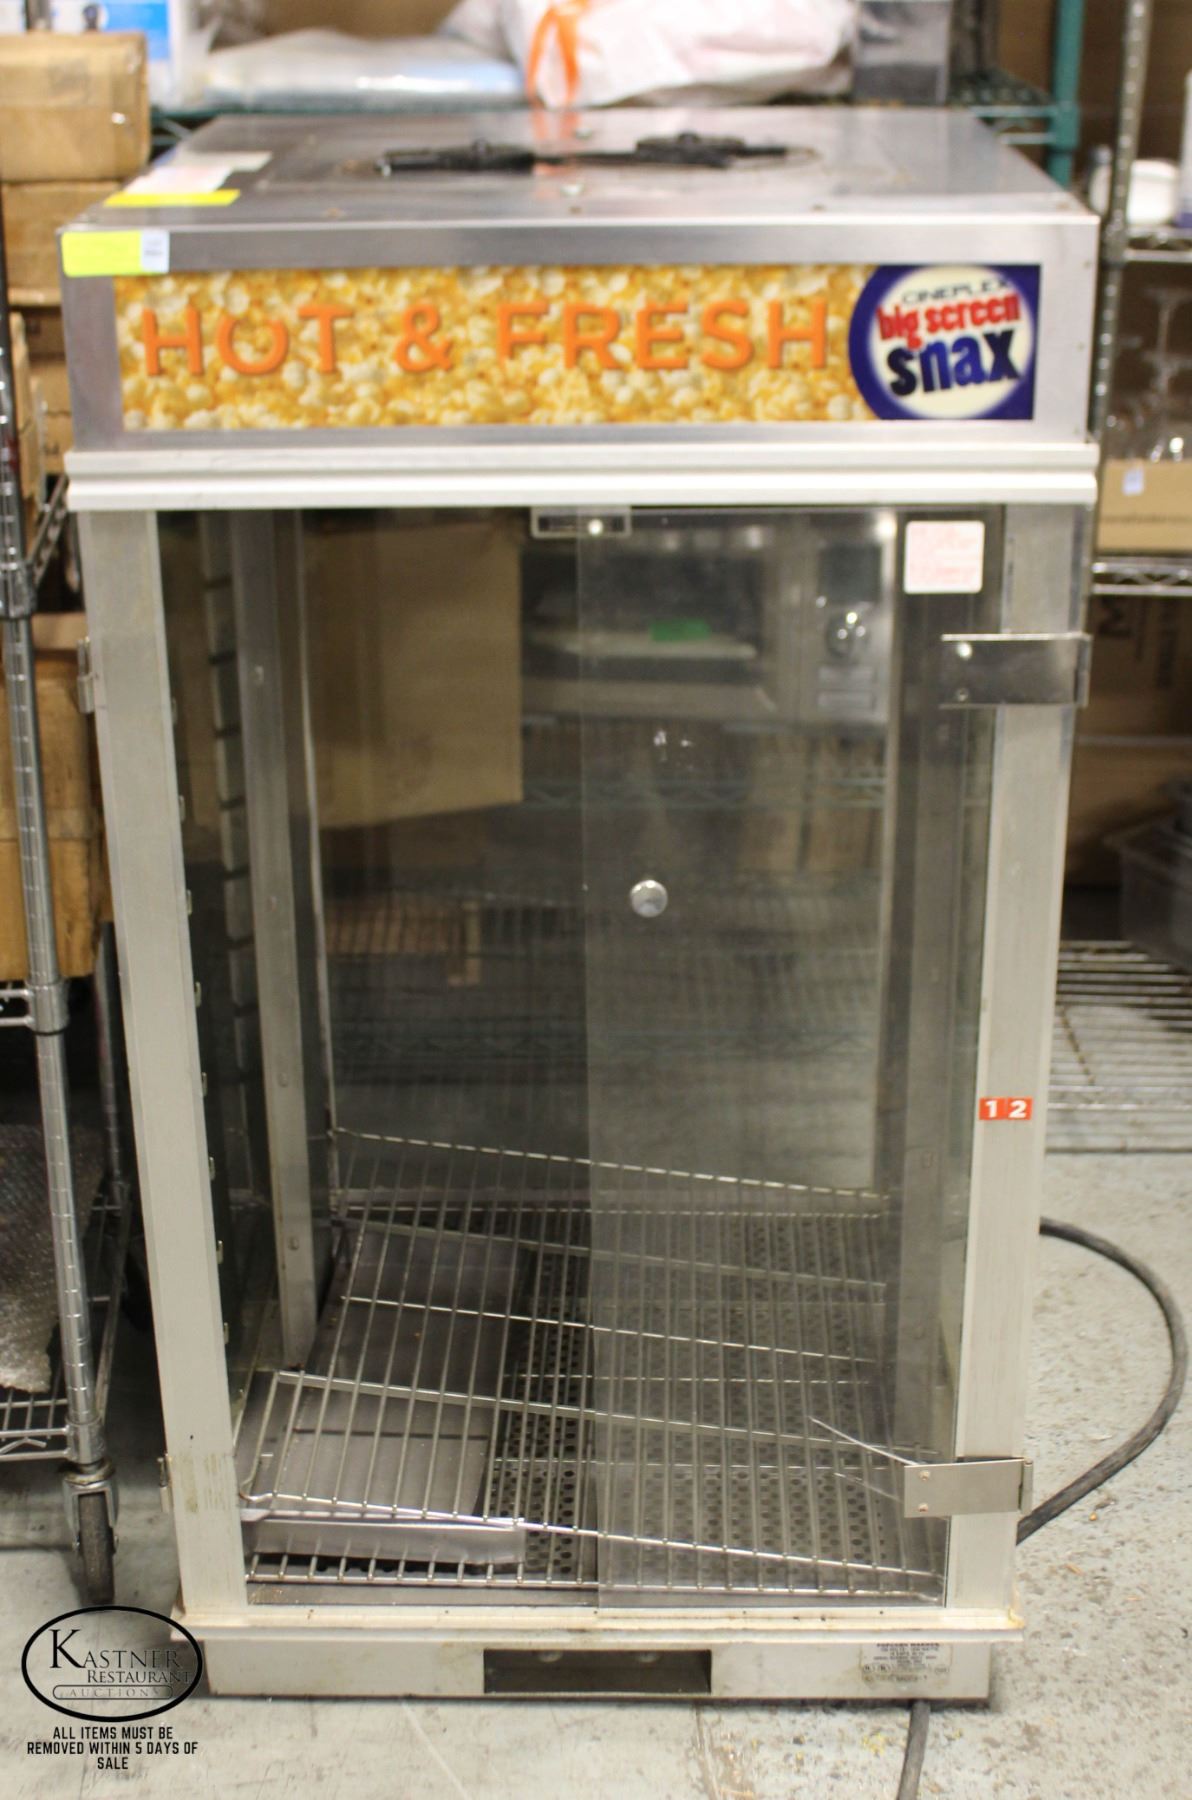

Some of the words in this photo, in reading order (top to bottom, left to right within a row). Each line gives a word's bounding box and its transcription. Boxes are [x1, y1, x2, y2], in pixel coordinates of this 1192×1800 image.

[141, 303, 354, 377] HOT
[394, 303, 453, 373] &
[496, 298, 829, 371] FRESH
[876, 305, 922, 350] big
[924, 293, 1020, 334] screen
[886, 329, 1021, 397] snax
